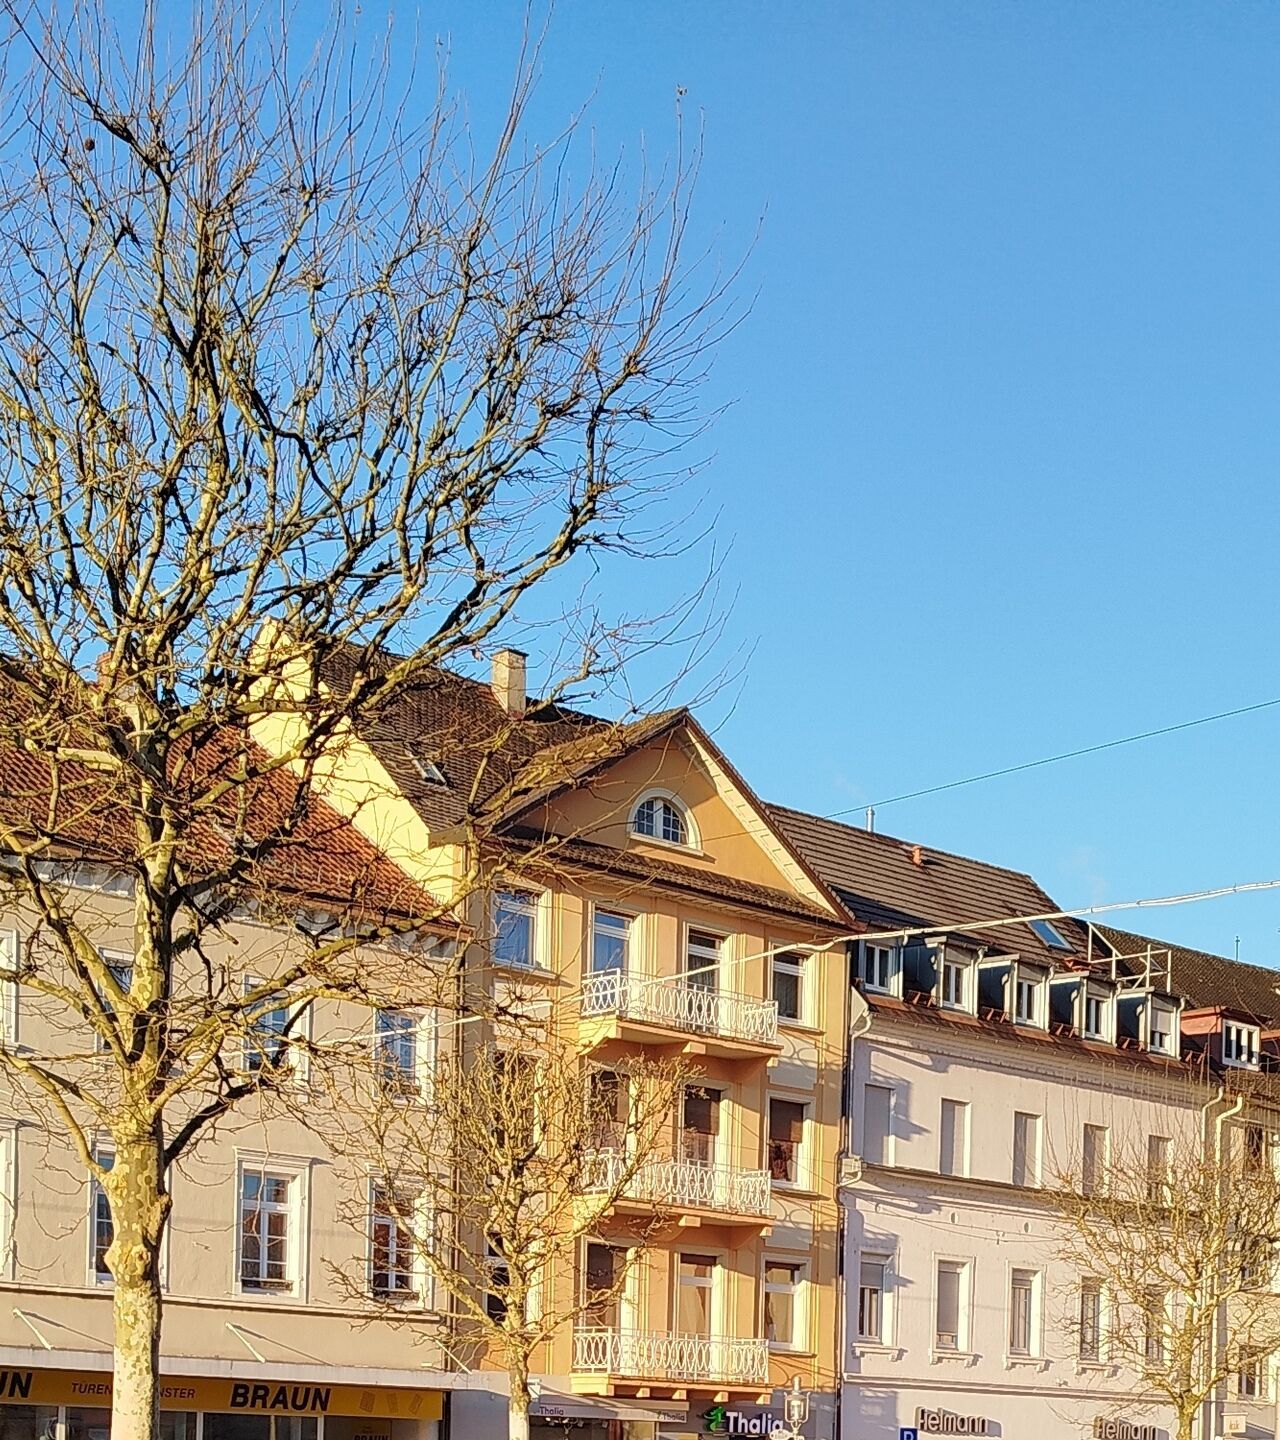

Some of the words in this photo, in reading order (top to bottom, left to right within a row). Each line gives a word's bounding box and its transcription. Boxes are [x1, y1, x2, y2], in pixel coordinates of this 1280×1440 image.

[230, 1383, 331, 1412] BRAUN
[539, 1406, 564, 1416] Thalia
[726, 1411, 784, 1435] Thalia
